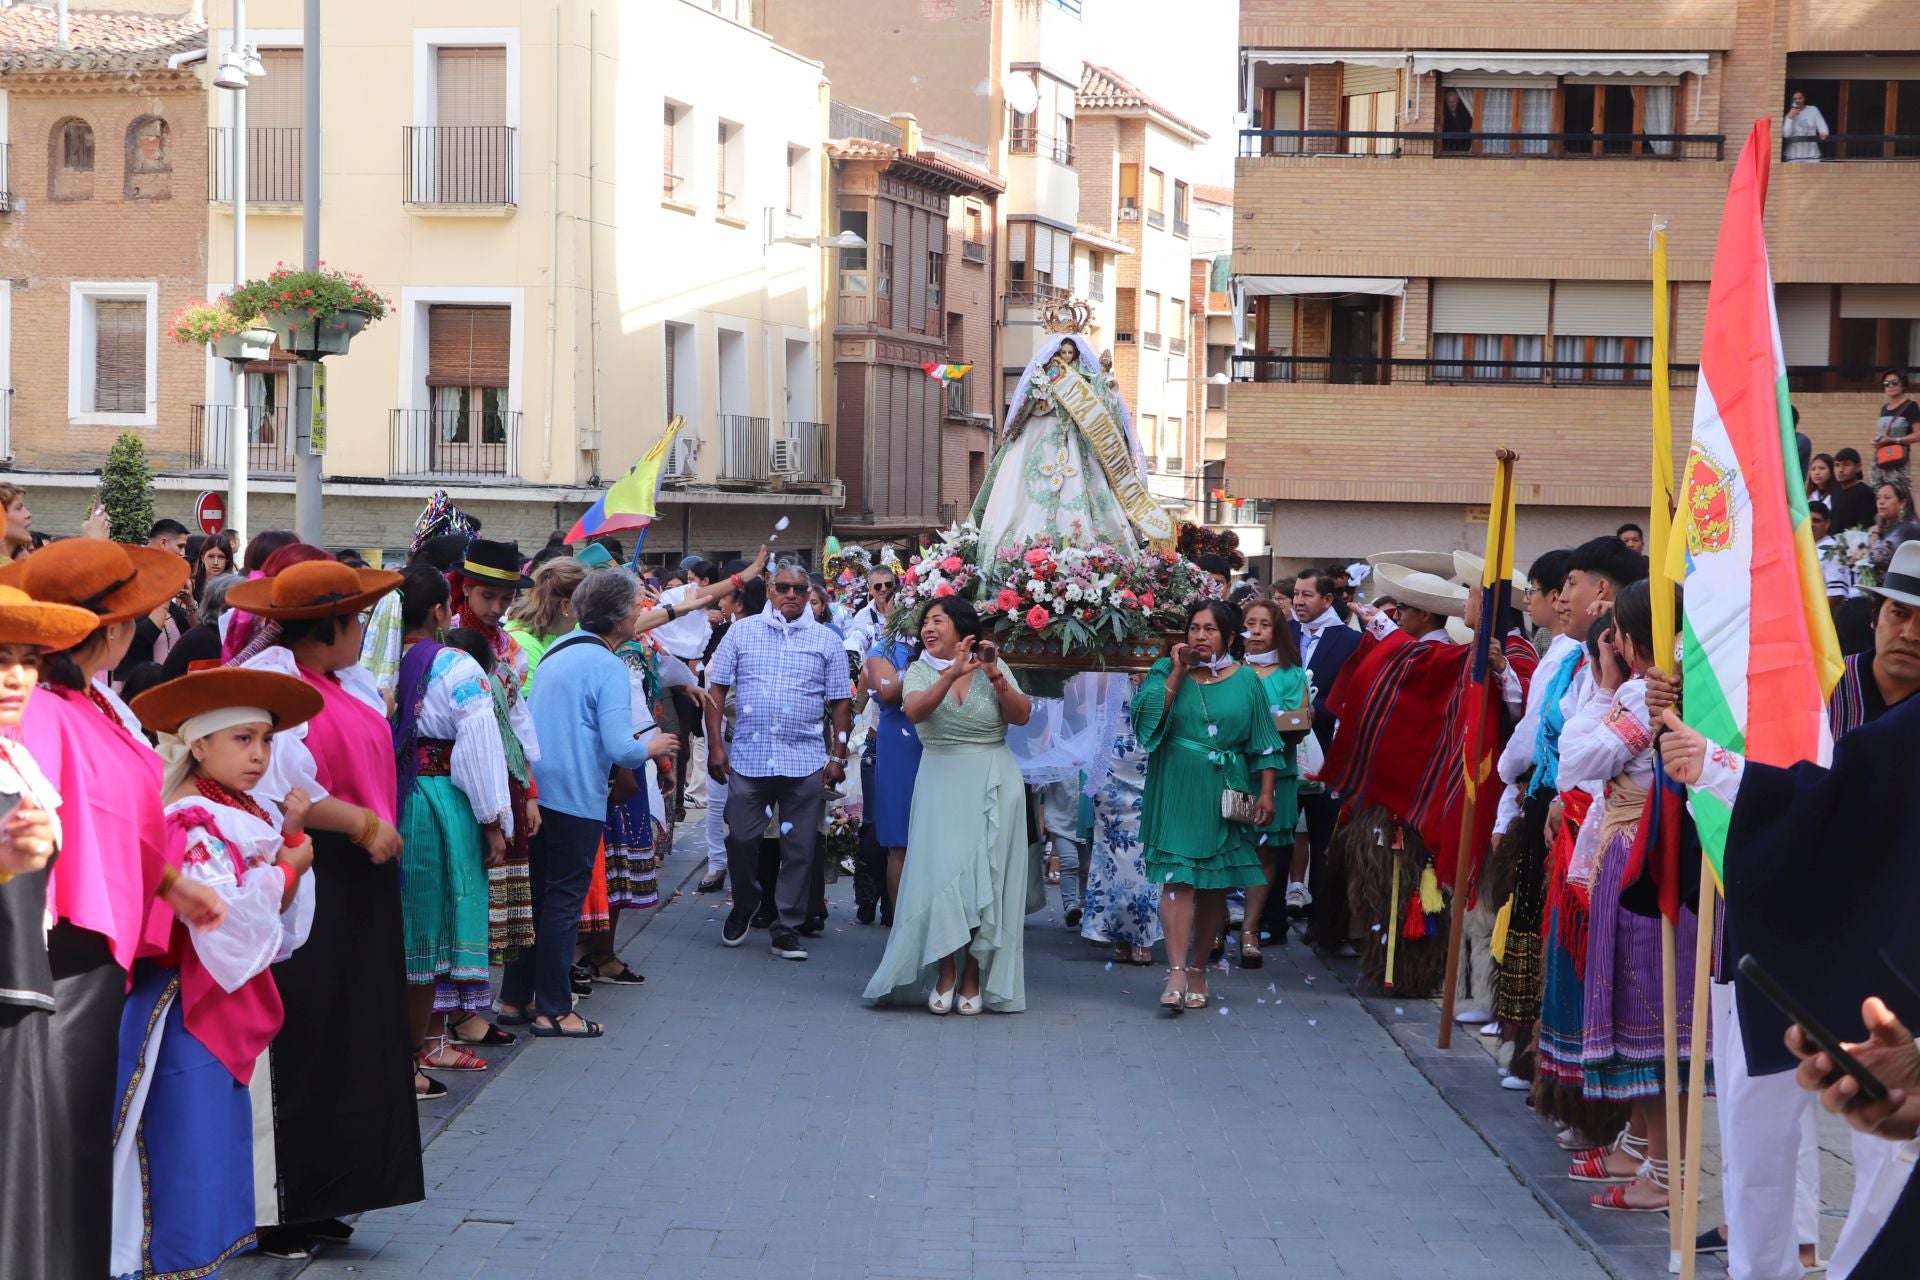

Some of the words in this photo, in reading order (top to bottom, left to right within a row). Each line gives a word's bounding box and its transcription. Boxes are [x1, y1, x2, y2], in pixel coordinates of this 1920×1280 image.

[1087, 412, 1124, 466] VIRGEN
[1110, 455, 1132, 487] DEL
[1119, 481, 1157, 521] CISNE
[1147, 515, 1169, 531] 2025
